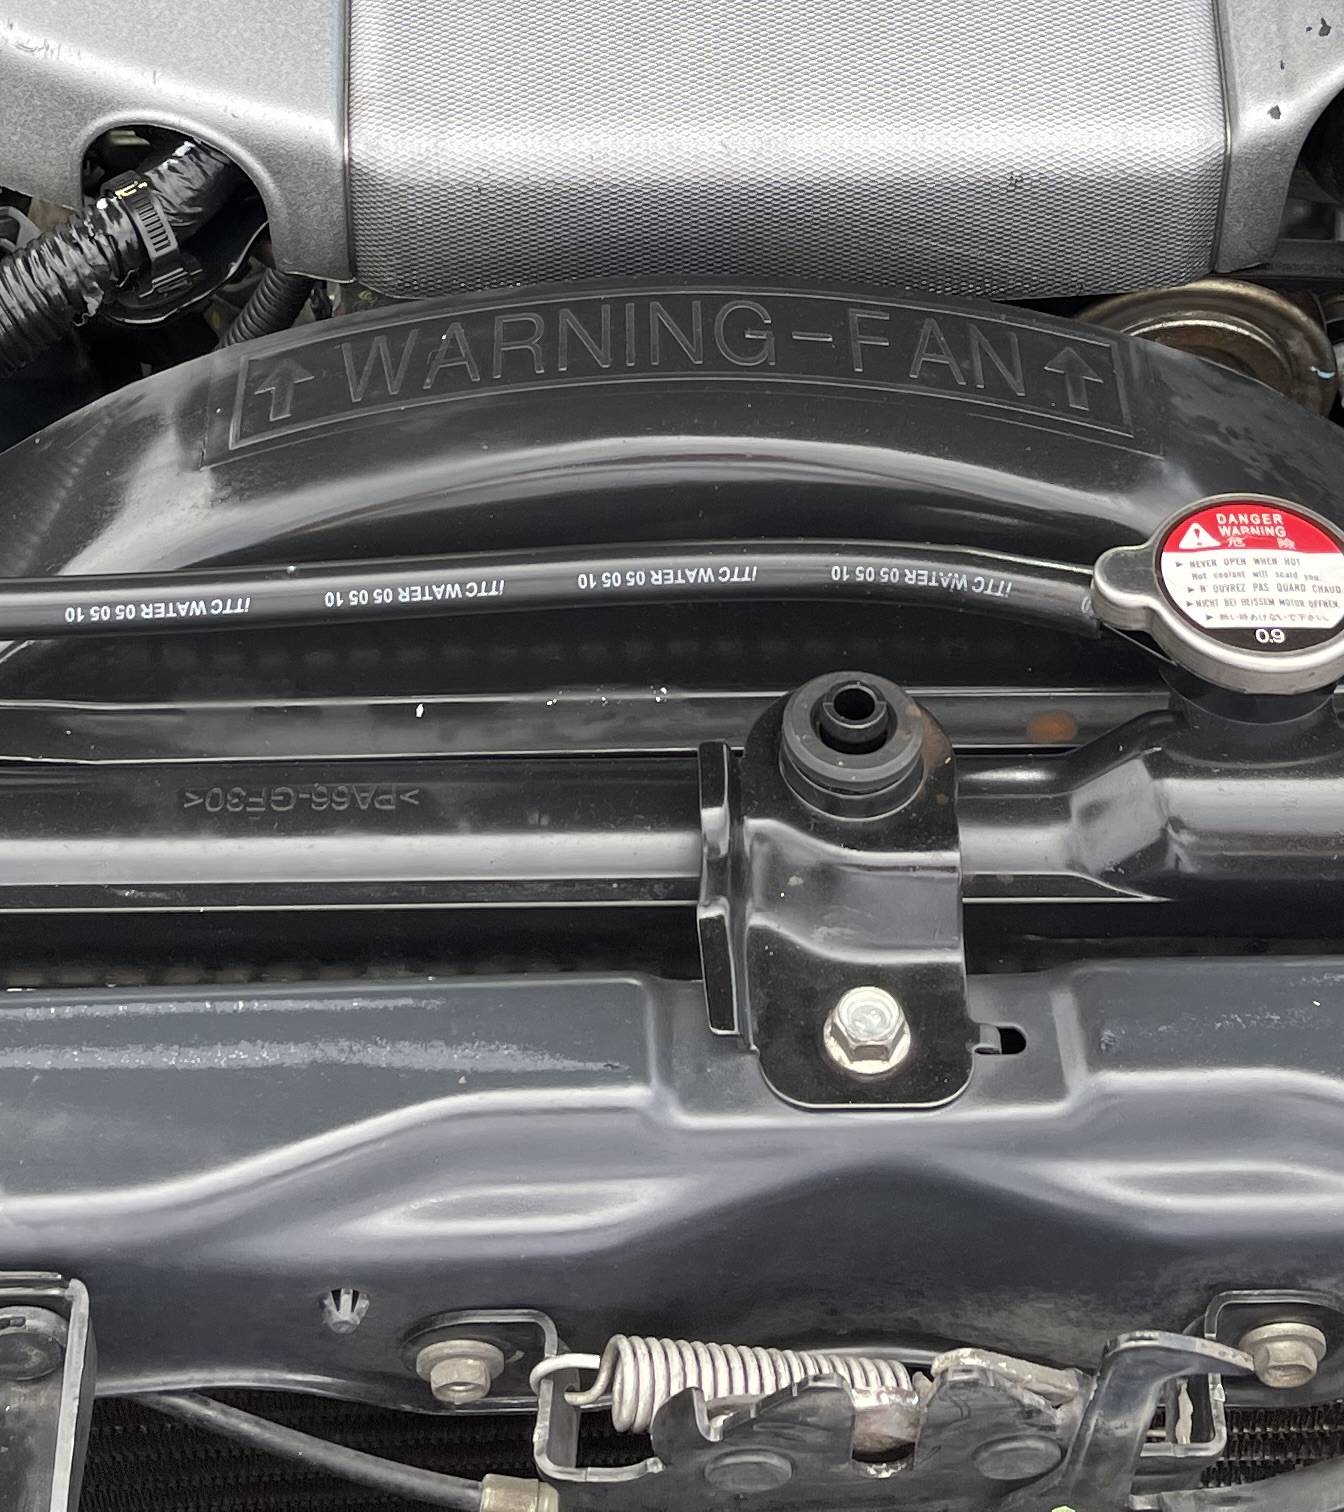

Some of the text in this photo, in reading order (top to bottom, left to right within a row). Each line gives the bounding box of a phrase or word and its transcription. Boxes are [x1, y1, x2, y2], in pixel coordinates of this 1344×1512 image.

[1215, 513, 1284, 525] DANGER
[1217, 525, 1287, 538] WARNING
[1189, 559, 1218, 568] NEVER
[1223, 557, 1247, 566] OPEN
[1252, 557, 1278, 566] WHEN
[577, 573, 598, 590] 10
[601, 572, 623, 589] 05
[626, 570, 647, 587] 05
[649, 568, 714, 588] WATER
[830, 565, 851, 583] 10
[855, 566, 876, 583] 05
[879, 567, 899, 584] 05
[903, 567, 969, 591] WATER
[1192, 571, 1208, 581] Hot
[1213, 570, 1246, 580] coolant
[1252, 570, 1268, 579] will
[1274, 570, 1299, 580] scald
[398, 582, 463, 603] WATER
[1212, 583, 1246, 593] OUVREZ
[1252, 582, 1269, 592] PAS
[1276, 583, 1307, 593] QUAND
[323, 592, 346, 608] 10
[347, 591, 370, 607] 05
[371, 589, 394, 606] 05
[1195, 598, 1219, 608] NICHT
[1224, 598, 1237, 607] BEI
[1240, 597, 1275, 607] HEISSEM
[1278, 598, 1306, 608] MOTOR
[64, 606, 86, 624] 10
[89, 605, 111, 622] 05
[114, 603, 136, 621] 05
[139, 599, 207, 619] WATER
[1254, 627, 1286, 644] 0.9
[183, 784, 421, 812] >PA66-GF30<
